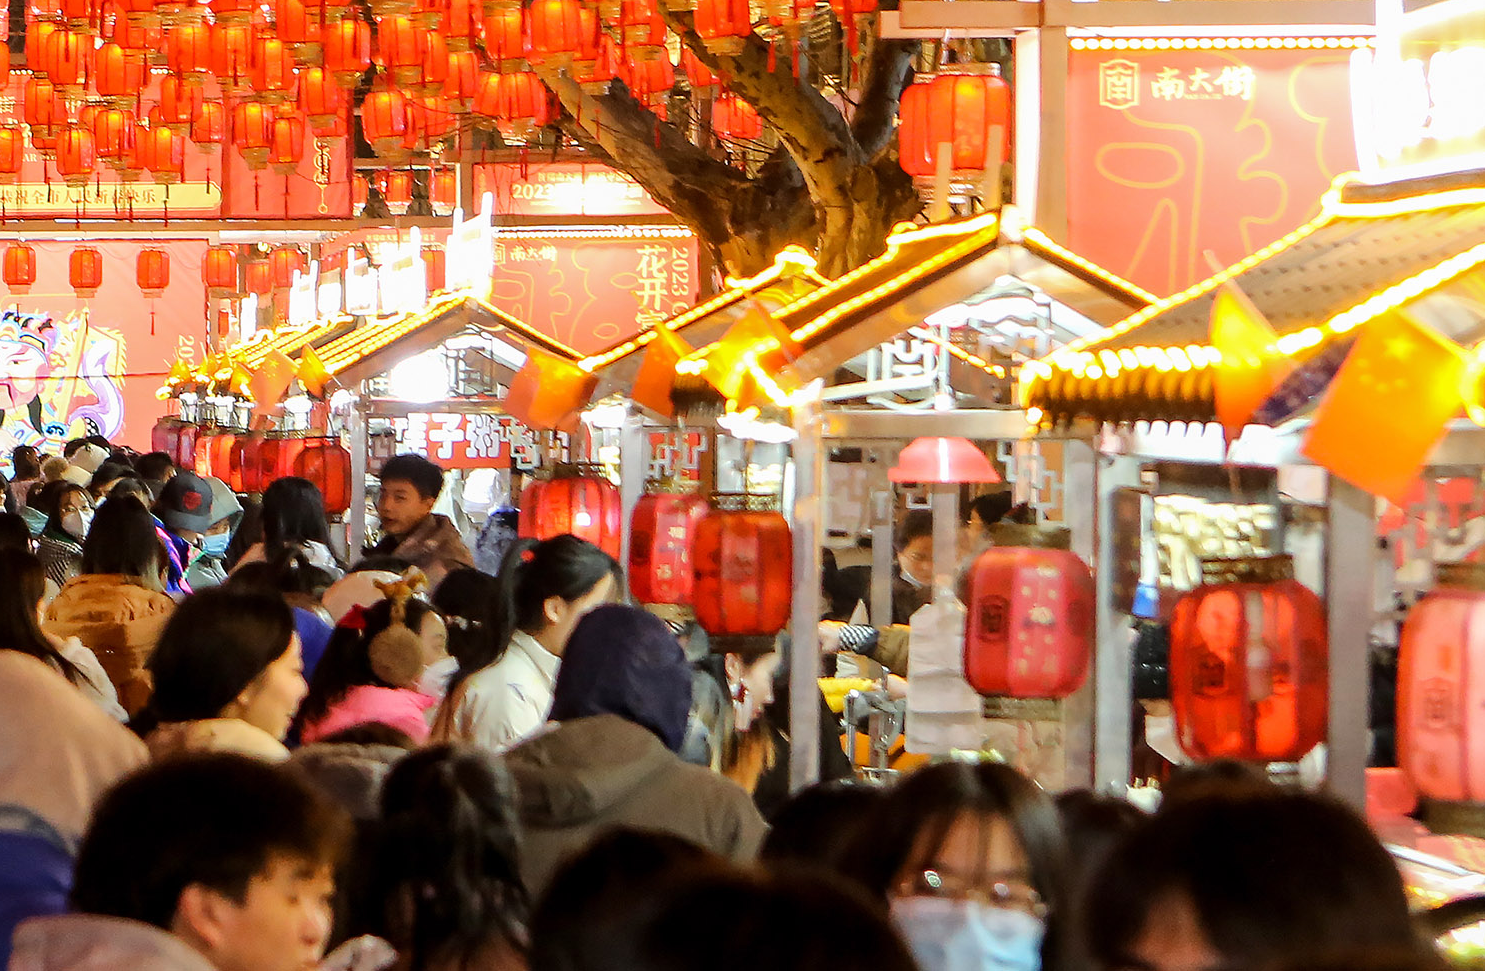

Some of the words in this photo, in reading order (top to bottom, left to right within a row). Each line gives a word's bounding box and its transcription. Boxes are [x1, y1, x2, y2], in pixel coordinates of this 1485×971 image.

[1150, 66, 1256, 101] 南大街
[635, 245, 668, 333] 花开
[671, 247, 689, 297] 2023
